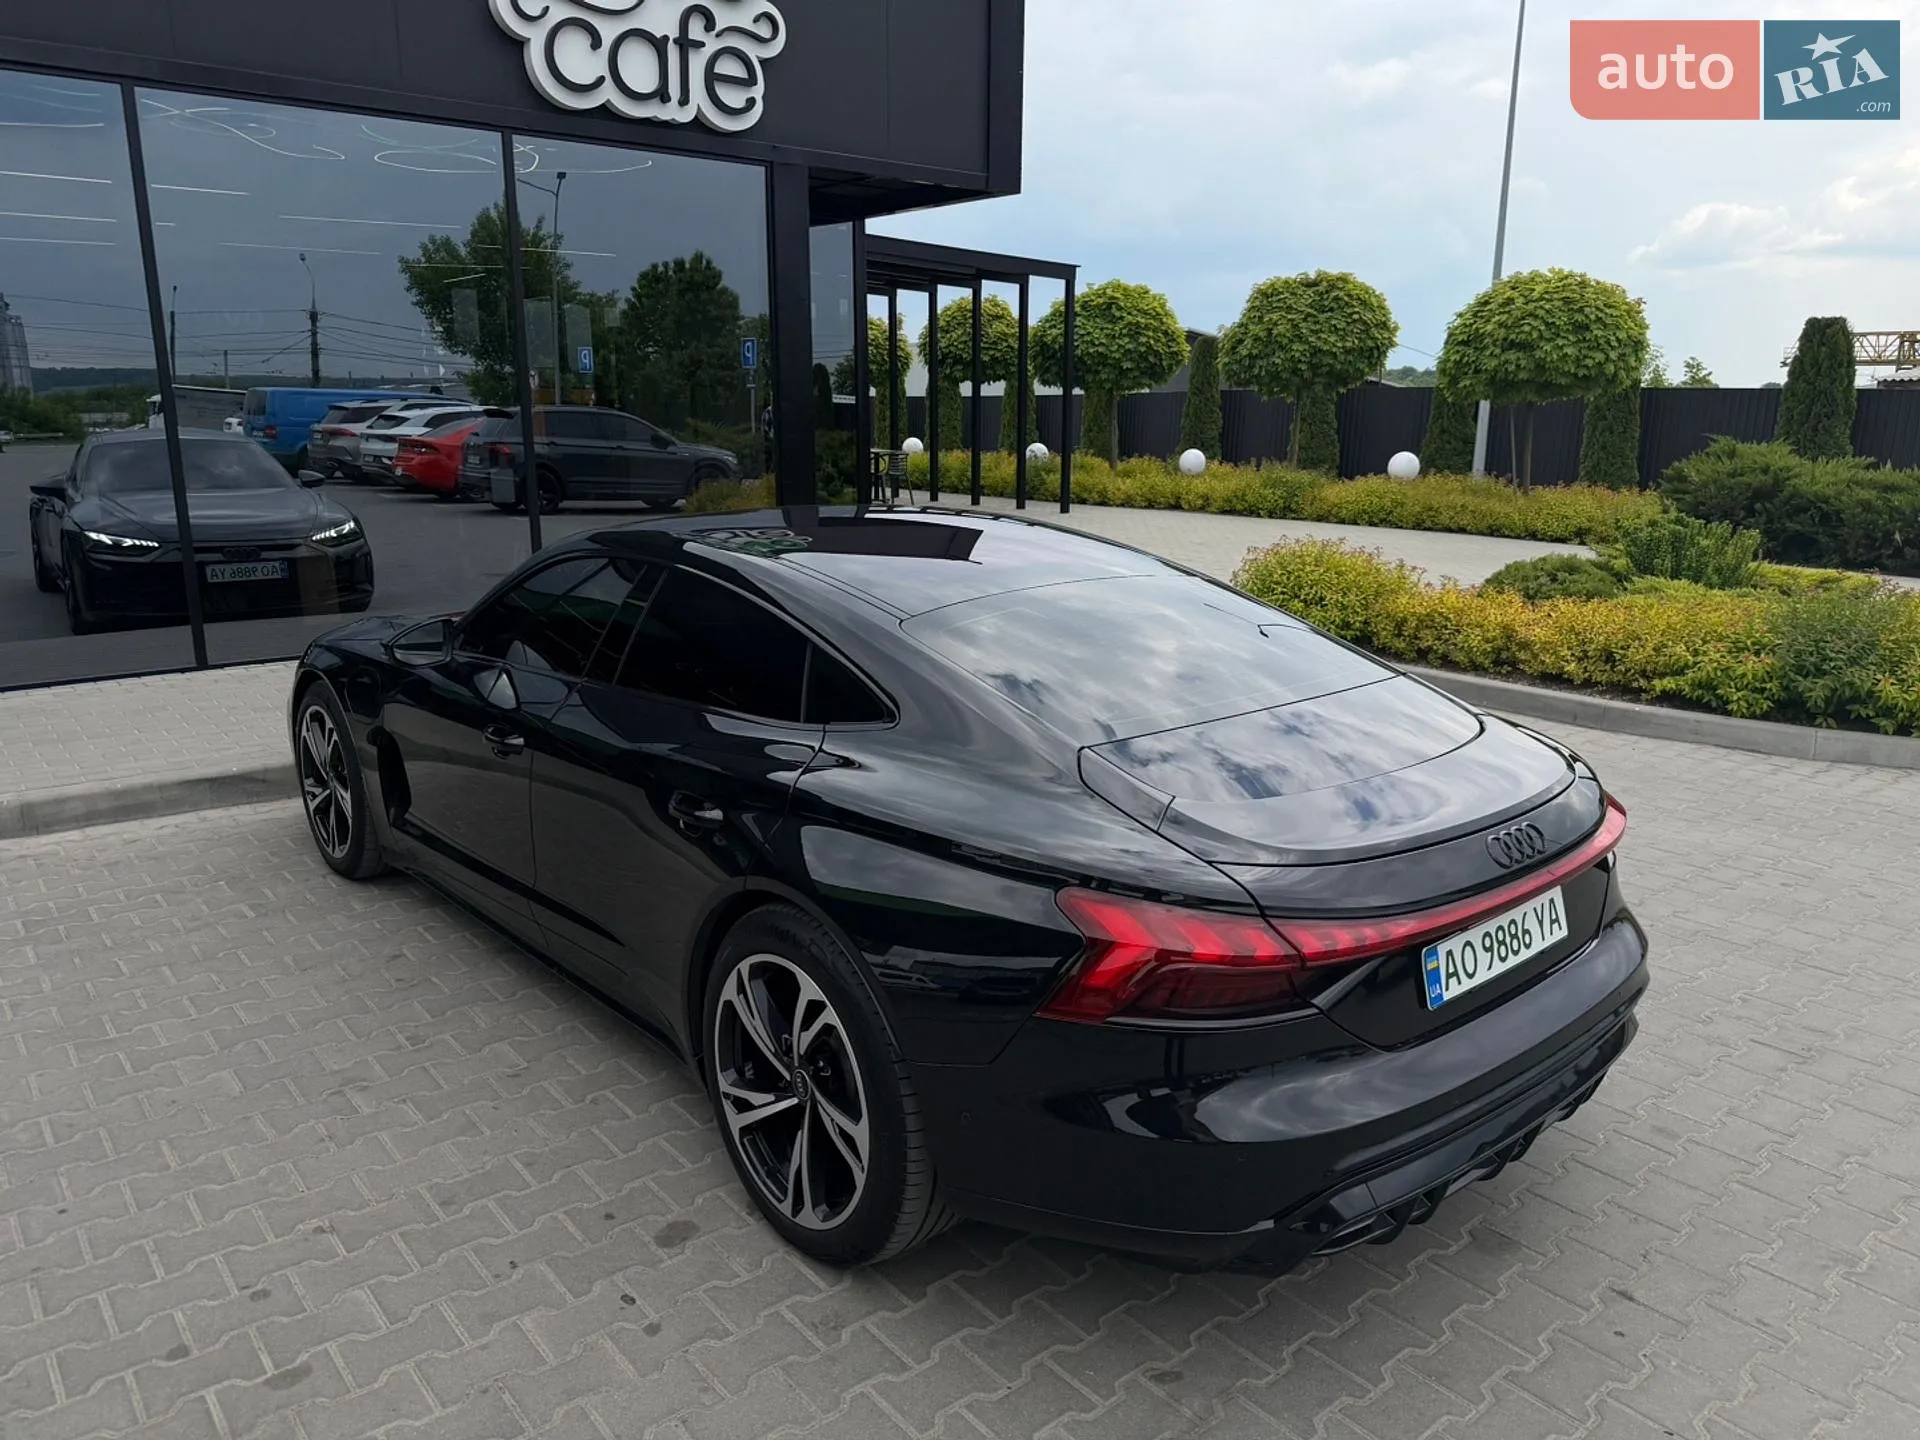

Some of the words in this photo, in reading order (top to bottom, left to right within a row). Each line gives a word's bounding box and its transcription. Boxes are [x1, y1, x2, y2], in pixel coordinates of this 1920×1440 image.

[1445, 940, 1478, 992] AO
[1482, 911, 1533, 971] 9886
[1533, 897, 1563, 942] YA
[1429, 983, 1442, 998] UA
